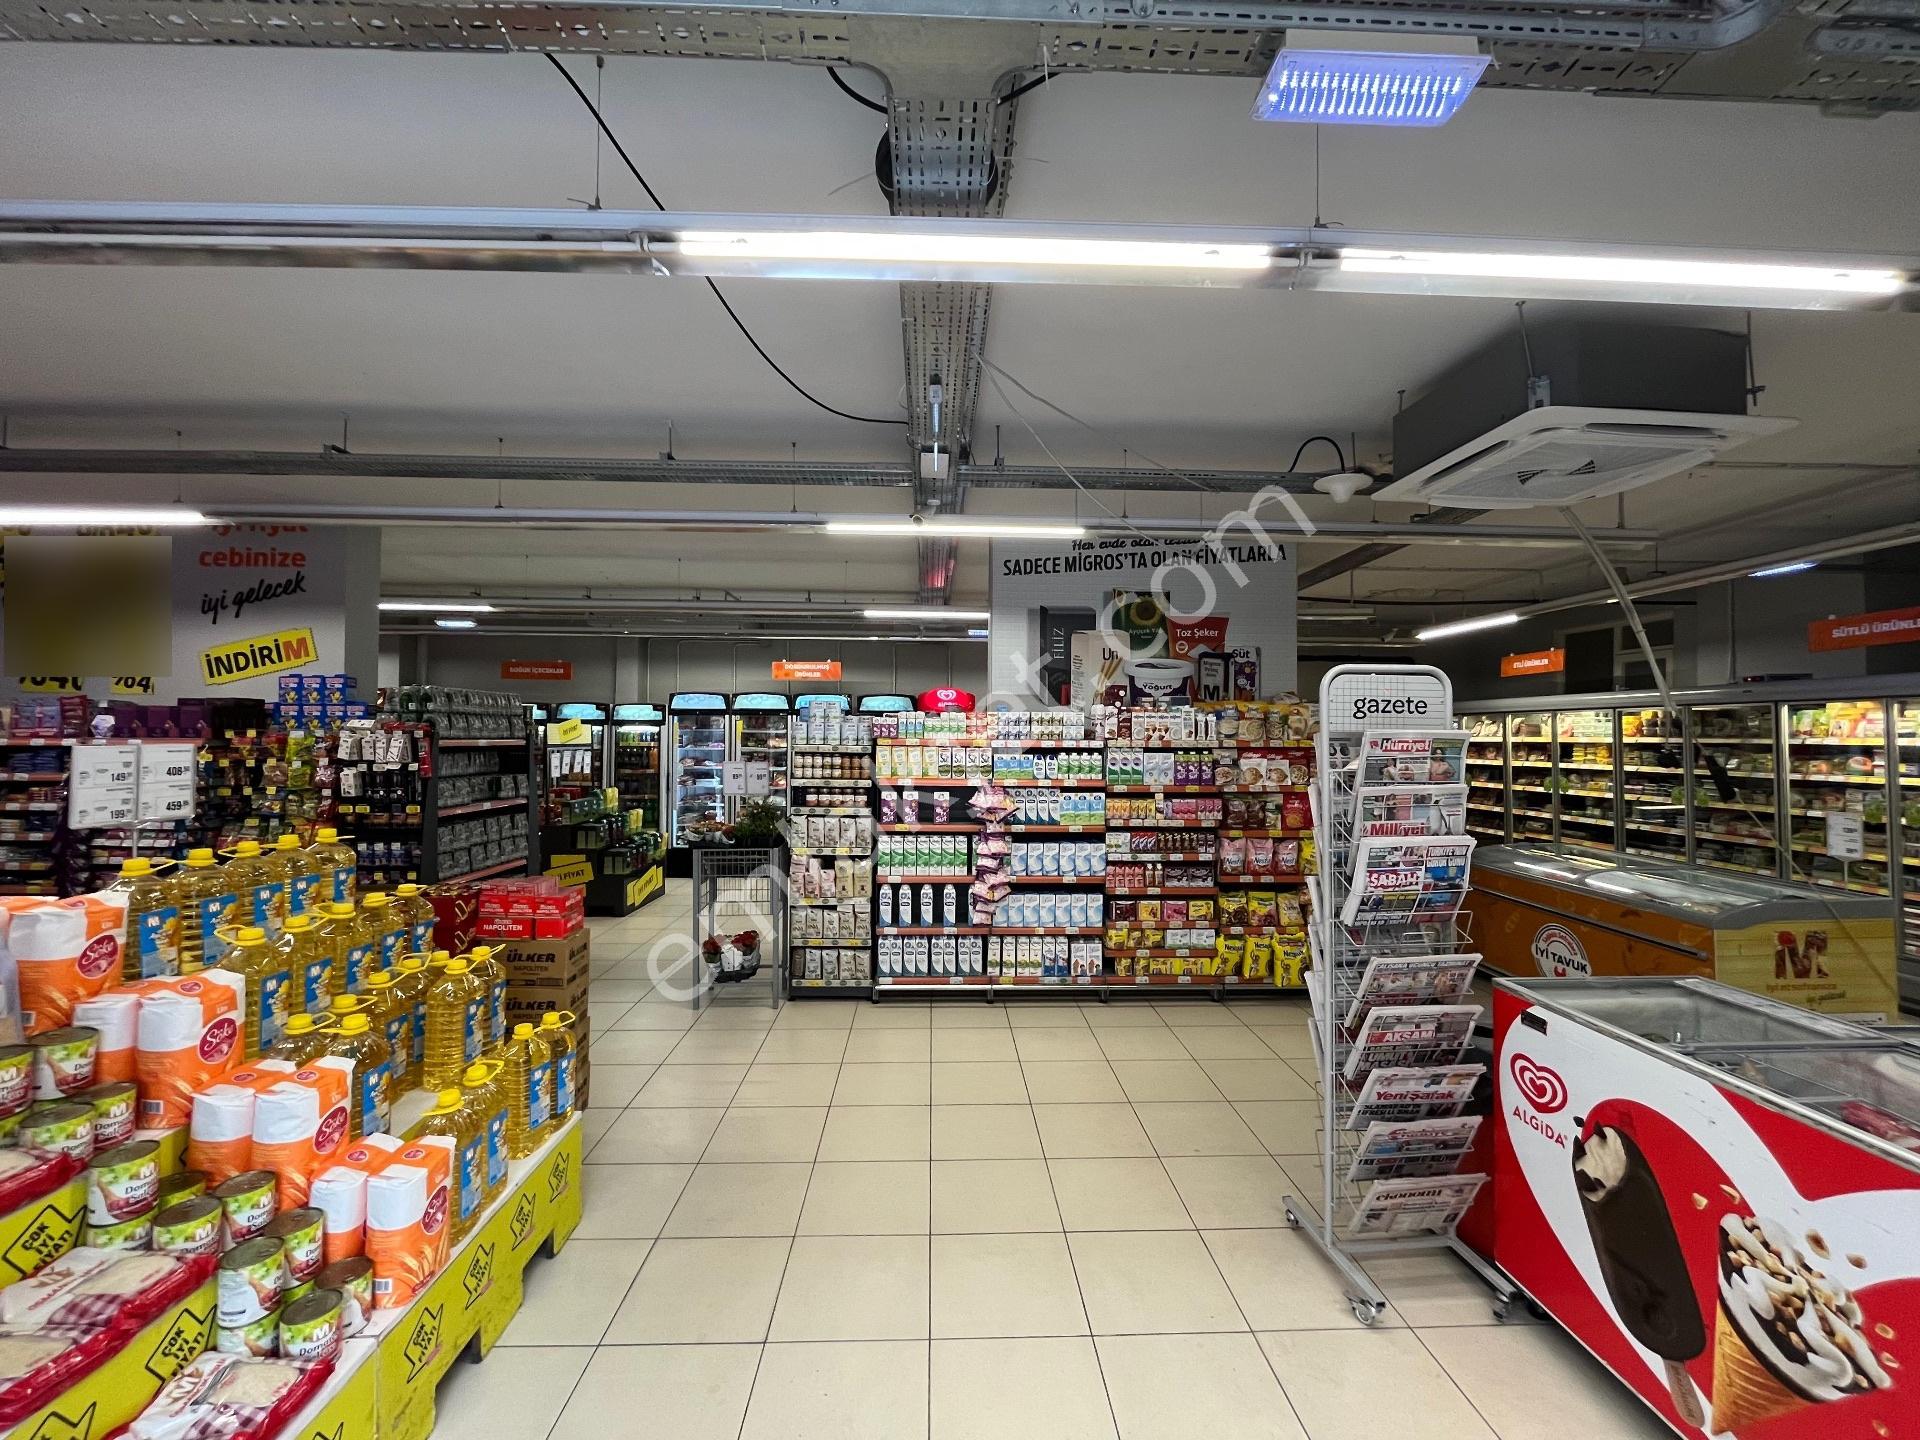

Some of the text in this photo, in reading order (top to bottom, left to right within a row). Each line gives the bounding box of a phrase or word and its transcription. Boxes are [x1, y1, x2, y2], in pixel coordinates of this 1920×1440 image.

[199, 546, 307, 568] cebinize
[1003, 558, 1061, 576] SADECE
[1064, 551, 1148, 573] MİGROS'TA
[1151, 550, 1192, 567] OLAN
[201, 570, 306, 625] iyi gelecek
[1176, 628, 1192, 638] Toz
[1194, 628, 1220, 641] Şeker
[1053, 627, 1065, 660] FİLİZ
[205, 636, 310, 679] İNDİRİM
[1102, 647, 1120, 661] Un
[1231, 648, 1251, 660] Süt
[1353, 696, 1428, 719] gazete
[1381, 738, 1431, 753] Hürriyet
[1370, 823, 1425, 836] Milliyet
[1370, 872, 1417, 887] SABAH
[506, 947, 556, 963] ÜLKER
[1535, 943, 1549, 960] İYİ
[1550, 951, 1588, 975] TAVUK
[505, 997, 556, 1011] ÜLKER
